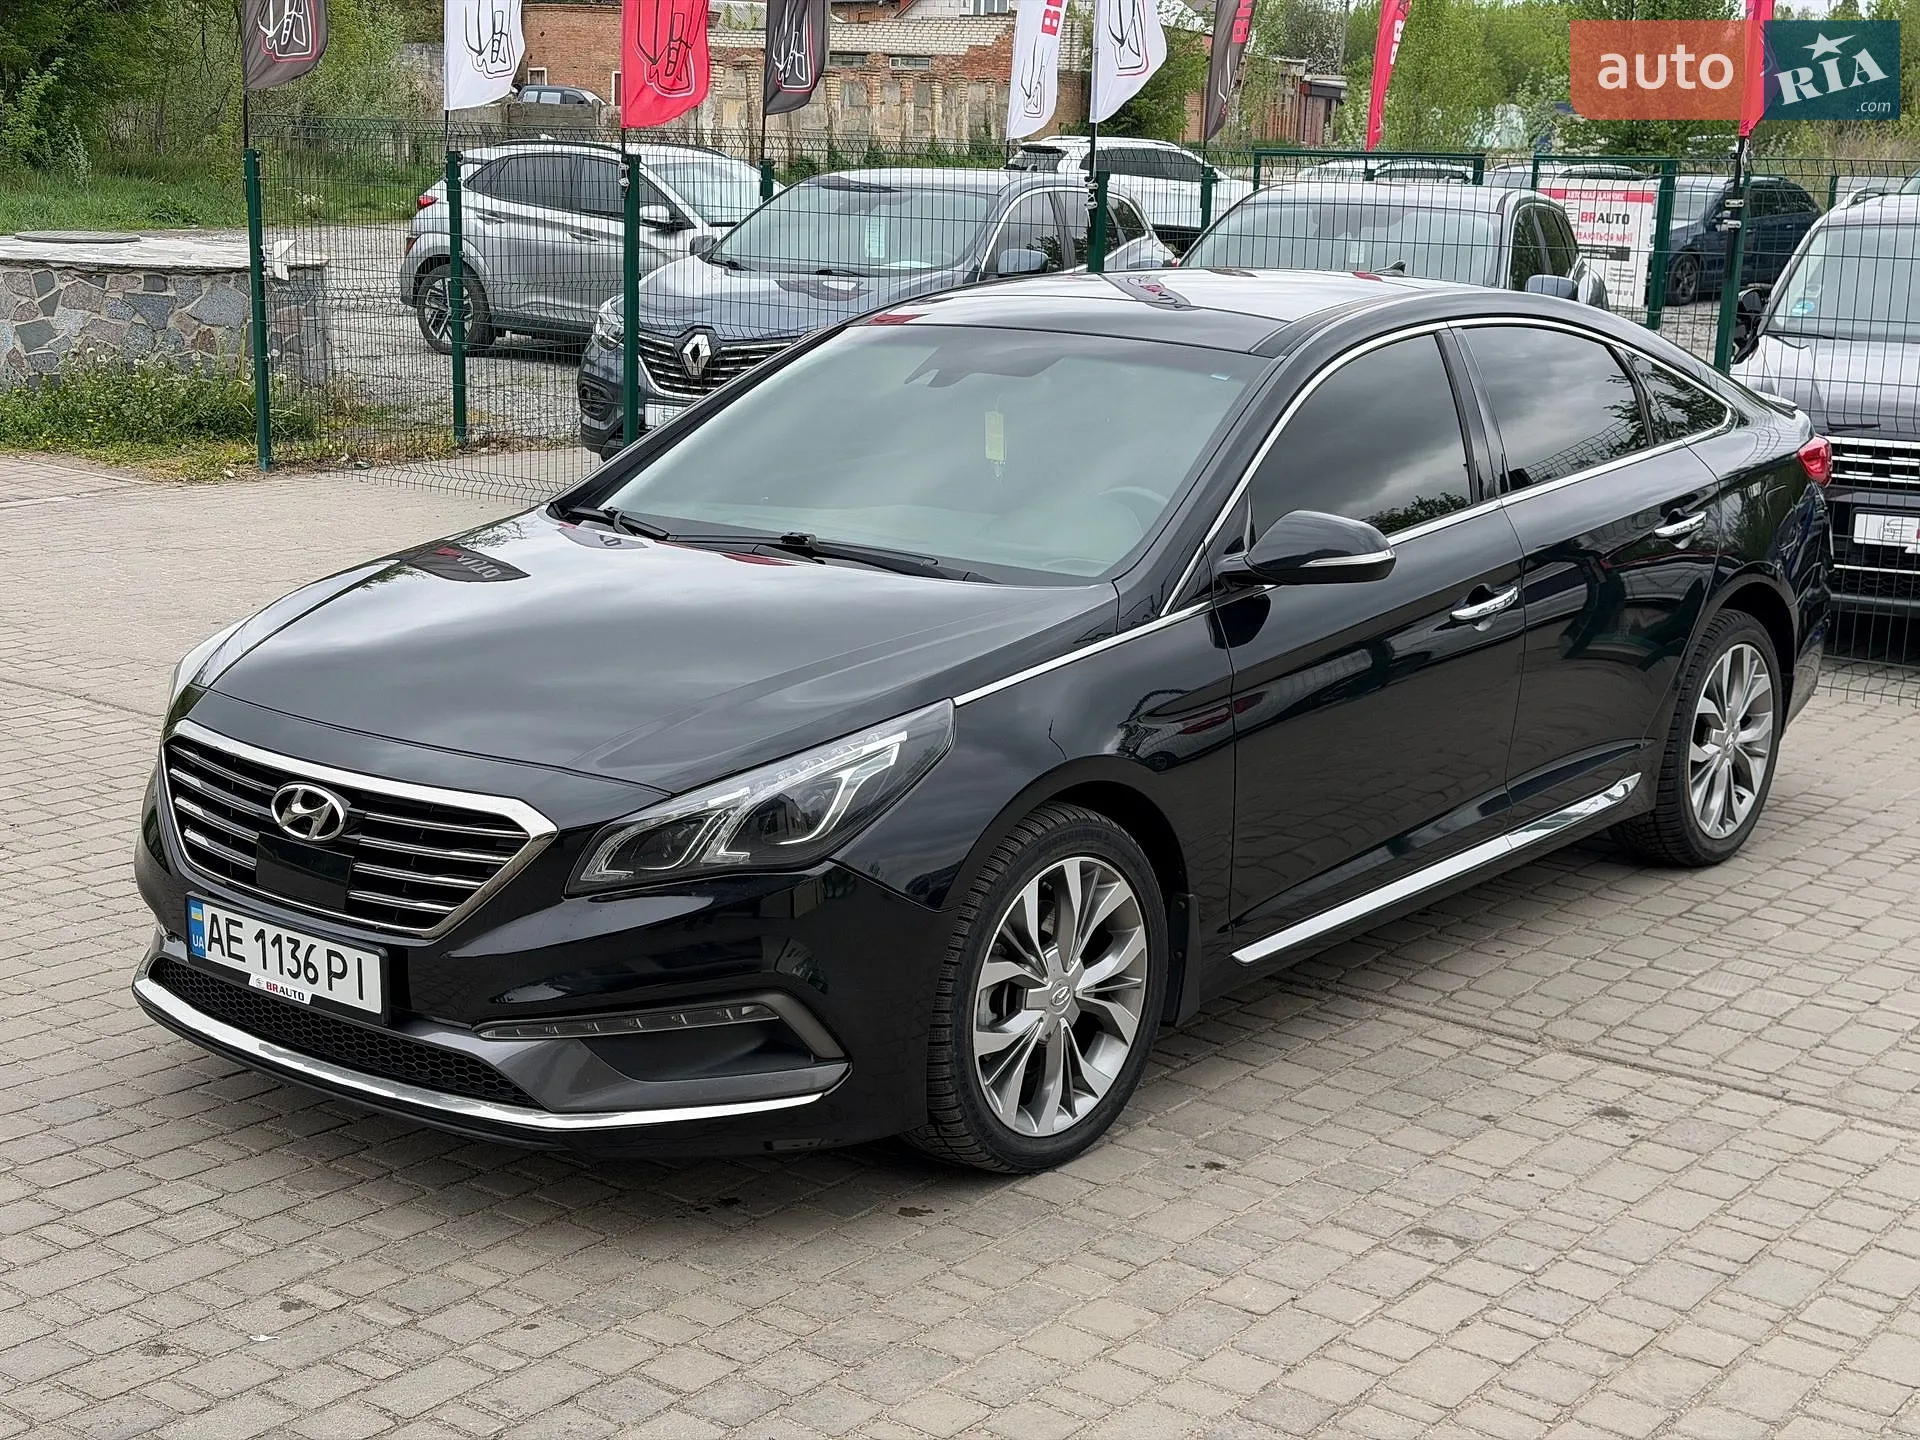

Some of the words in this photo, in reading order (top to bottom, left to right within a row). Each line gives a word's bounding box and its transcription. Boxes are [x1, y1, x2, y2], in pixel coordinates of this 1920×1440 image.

[1581, 212, 1630, 225] BRAUTO
[192, 933, 205, 949] UA
[208, 913, 246, 963] AE
[254, 928, 319, 985] 1136
[326, 948, 364, 1000] PI
[266, 981, 305, 1001] BRAUTO
